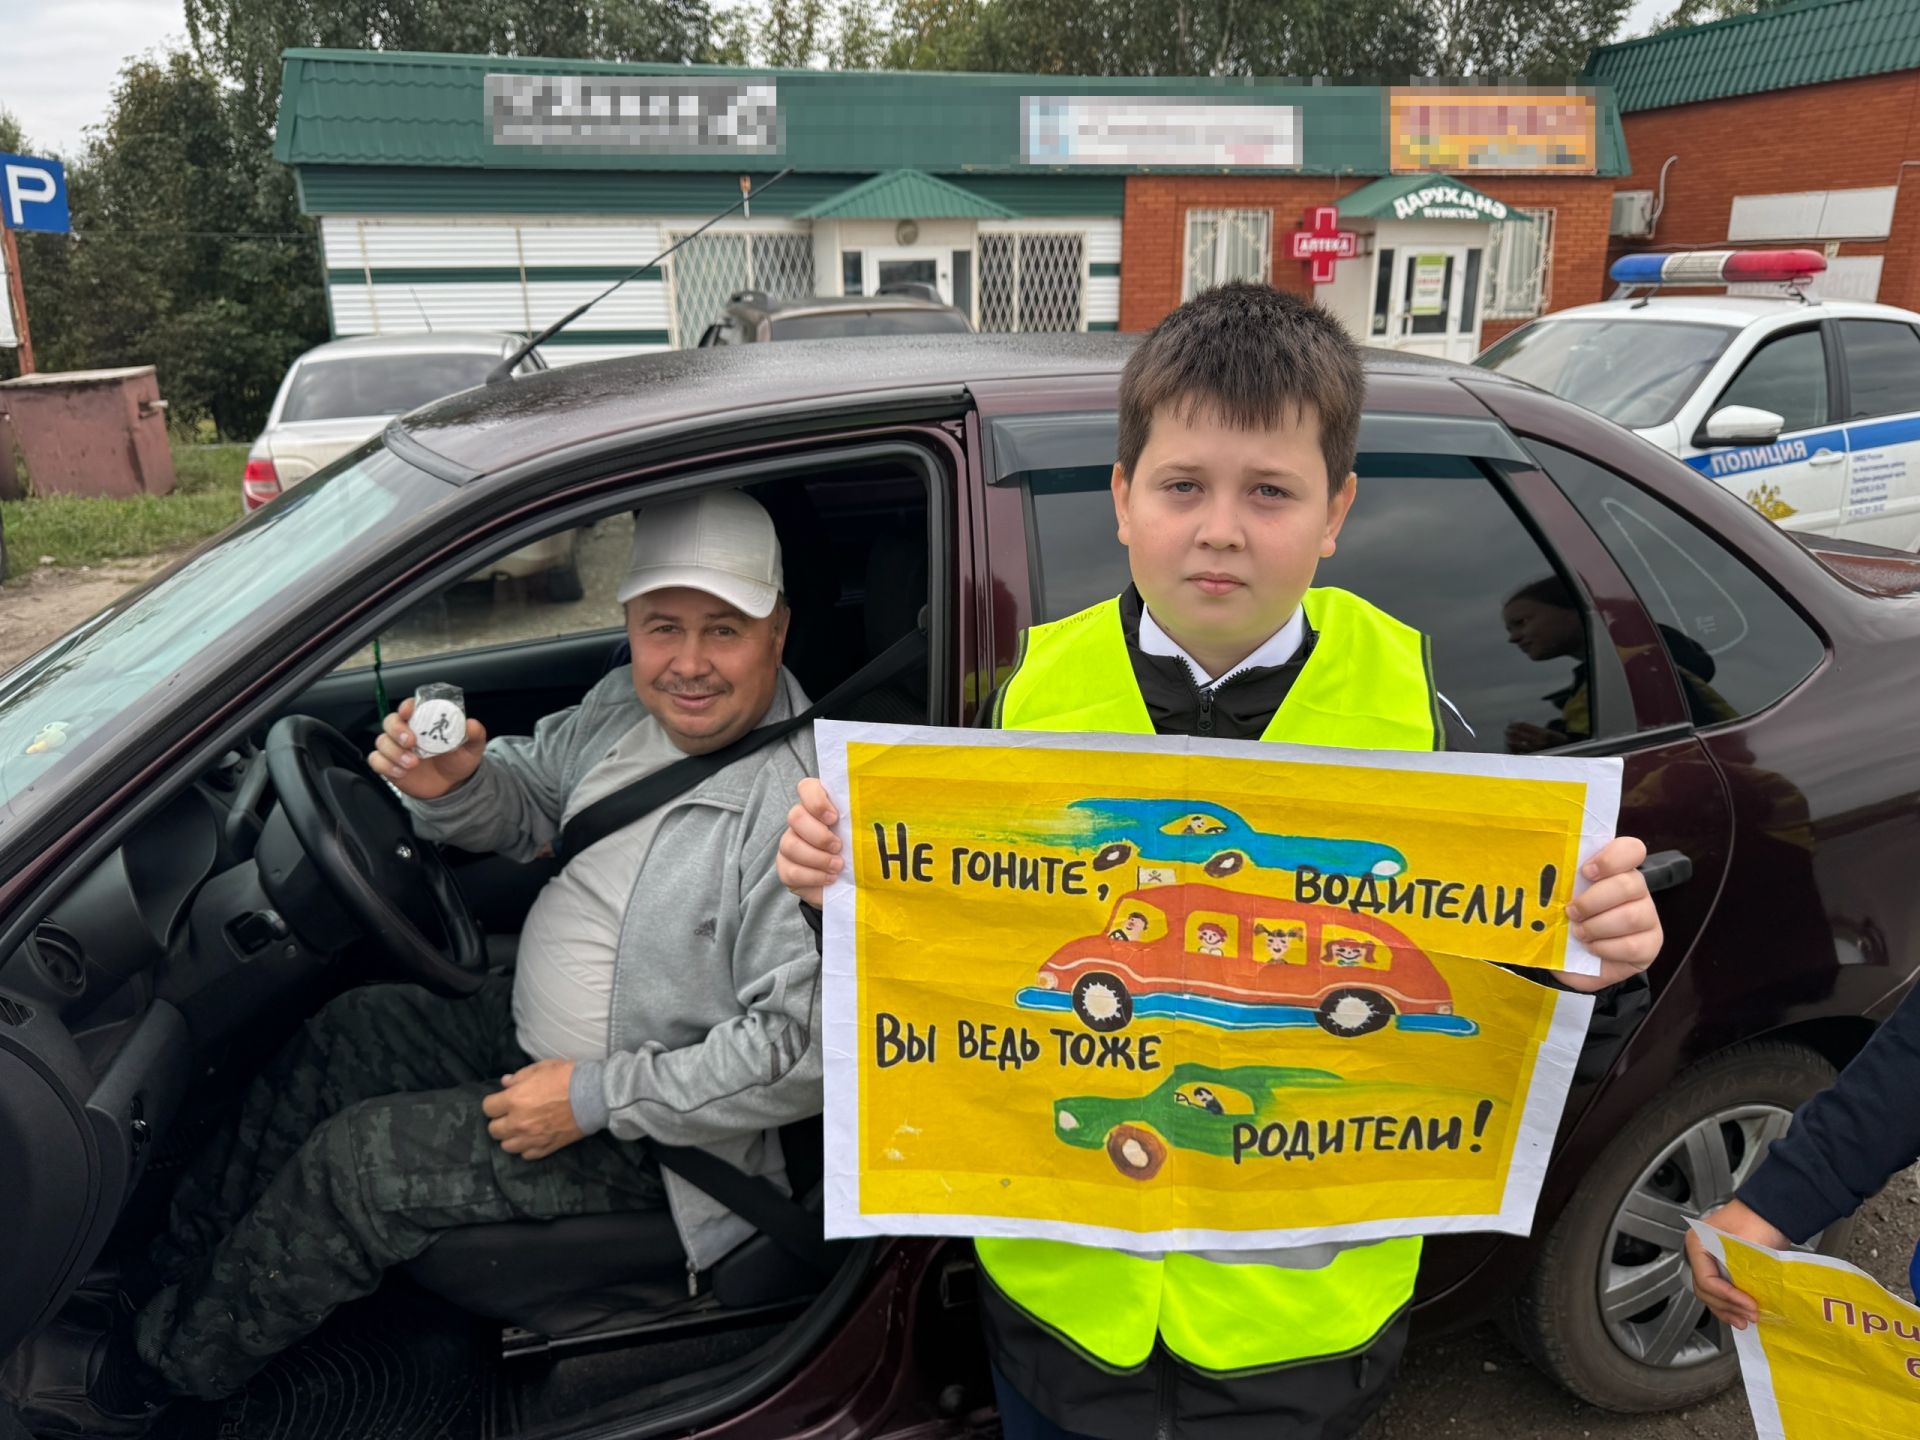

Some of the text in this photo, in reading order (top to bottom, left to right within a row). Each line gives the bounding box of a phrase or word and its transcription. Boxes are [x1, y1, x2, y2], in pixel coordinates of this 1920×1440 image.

[5, 164, 56, 225] P
[1423, 206, 1479, 219] ПУНКТЫ
[1300, 237, 1349, 251] АПТЕКА
[1711, 440, 1808, 474] ПОЛИЦИЯ
[1295, 864, 1557, 932] ВОДИТЕЛИ!
[957, 1020, 1041, 1071] ВЕДЬ
[1050, 1028, 1162, 1071] ТОЖЕ
[1233, 1099, 1494, 1165] РОДИТЕЛИ!
